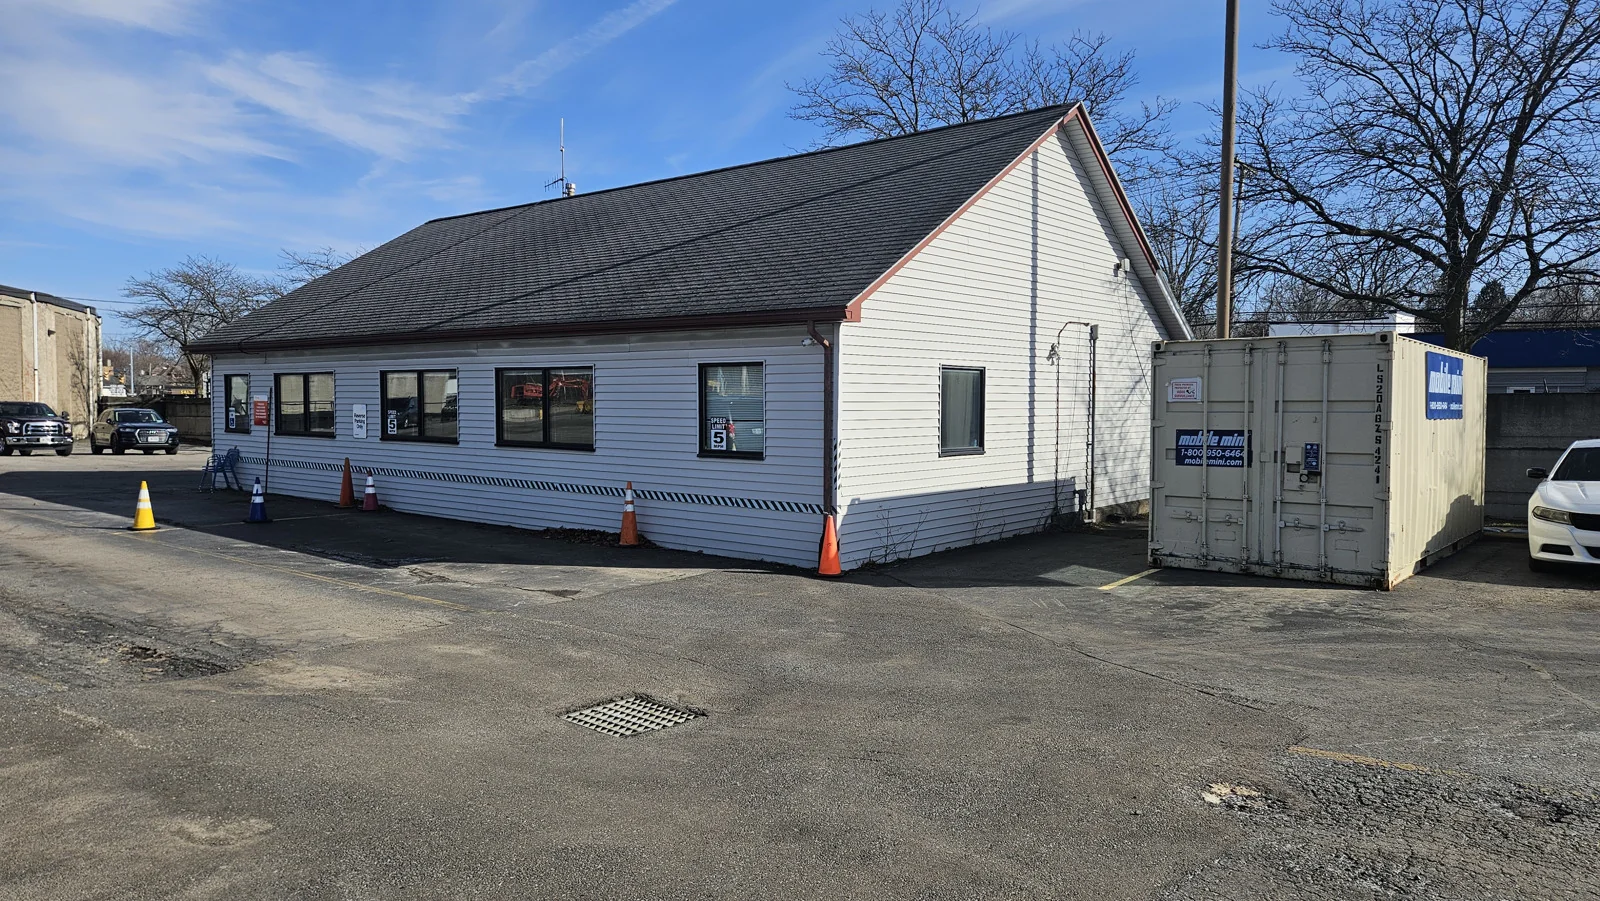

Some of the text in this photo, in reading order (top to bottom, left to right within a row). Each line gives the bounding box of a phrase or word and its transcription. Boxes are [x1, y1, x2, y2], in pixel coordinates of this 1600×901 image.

[388, 419, 396, 429] 5
[713, 432, 724, 444] 5
[1178, 431, 1246, 447] moble min
